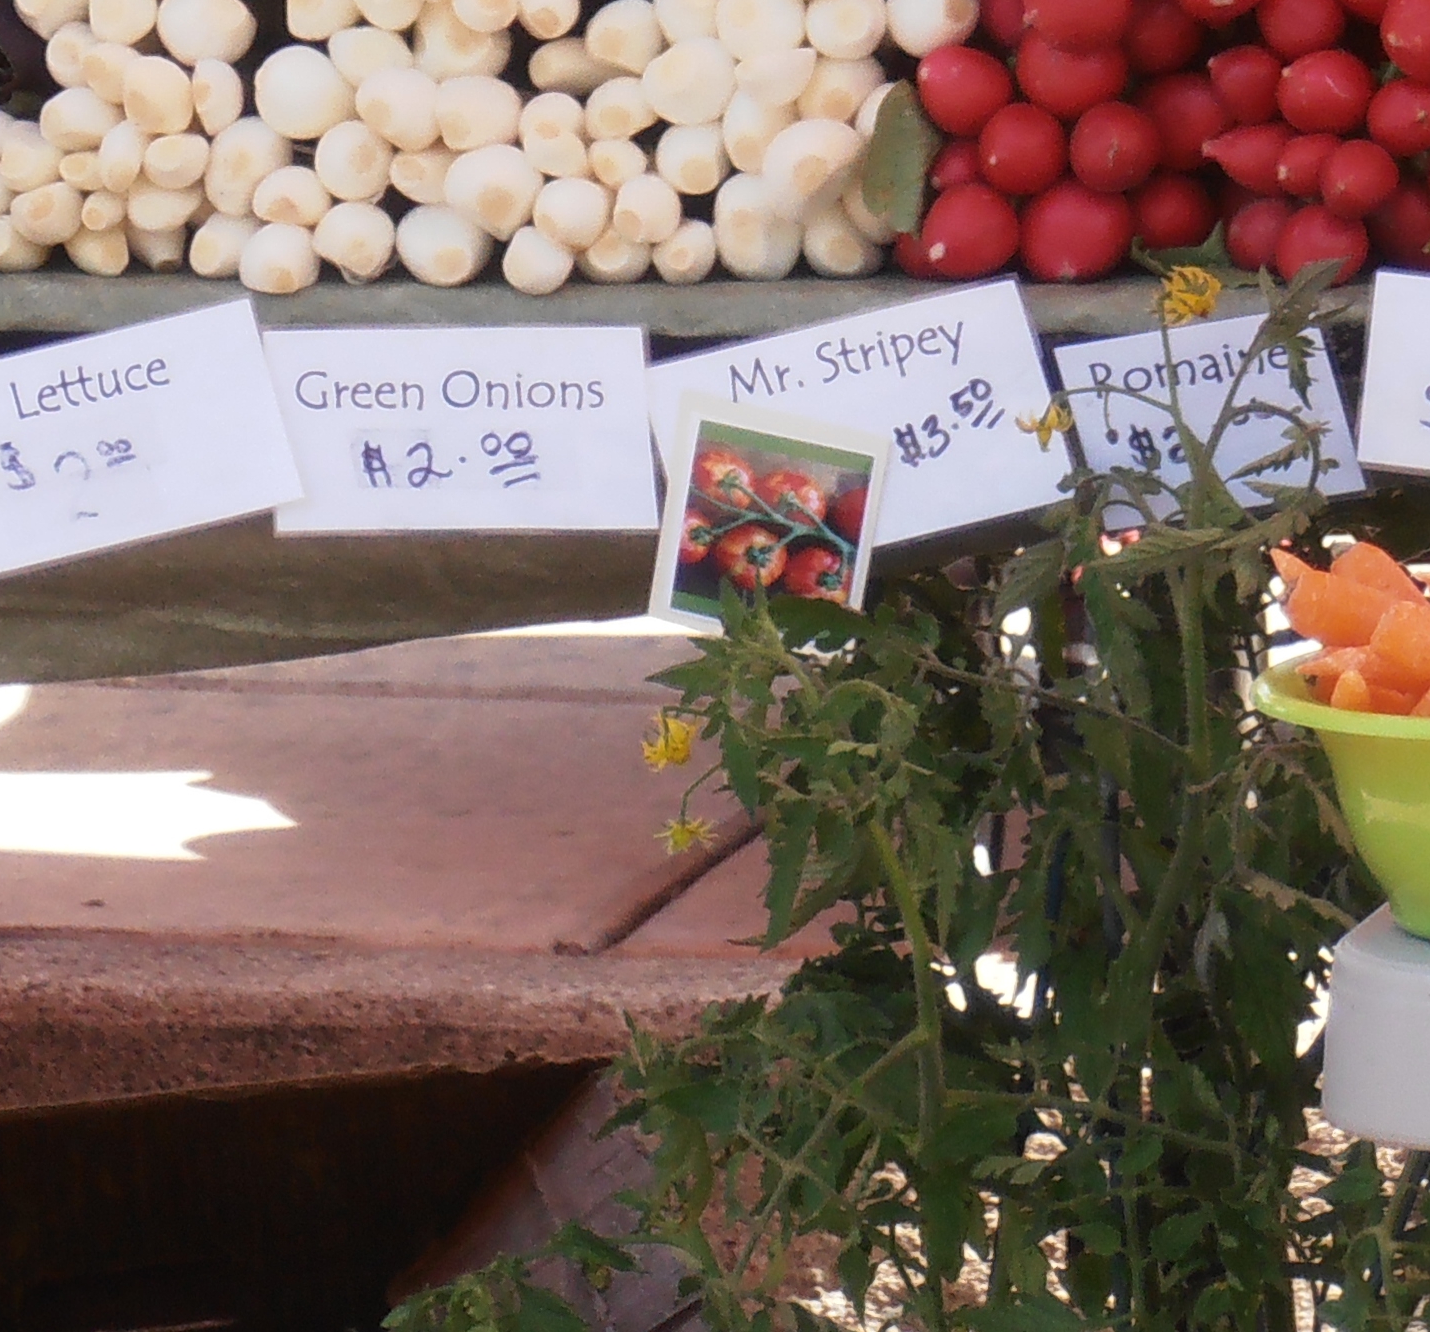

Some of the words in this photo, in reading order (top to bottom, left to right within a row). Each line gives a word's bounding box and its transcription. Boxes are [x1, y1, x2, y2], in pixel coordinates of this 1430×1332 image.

[10, 358, 170, 419] Lettuce
[295, 371, 424, 410] Green
[442, 370, 605, 410] Onions
[729, 357, 804, 402] Mr.
[815, 320, 963, 384] Stripey
